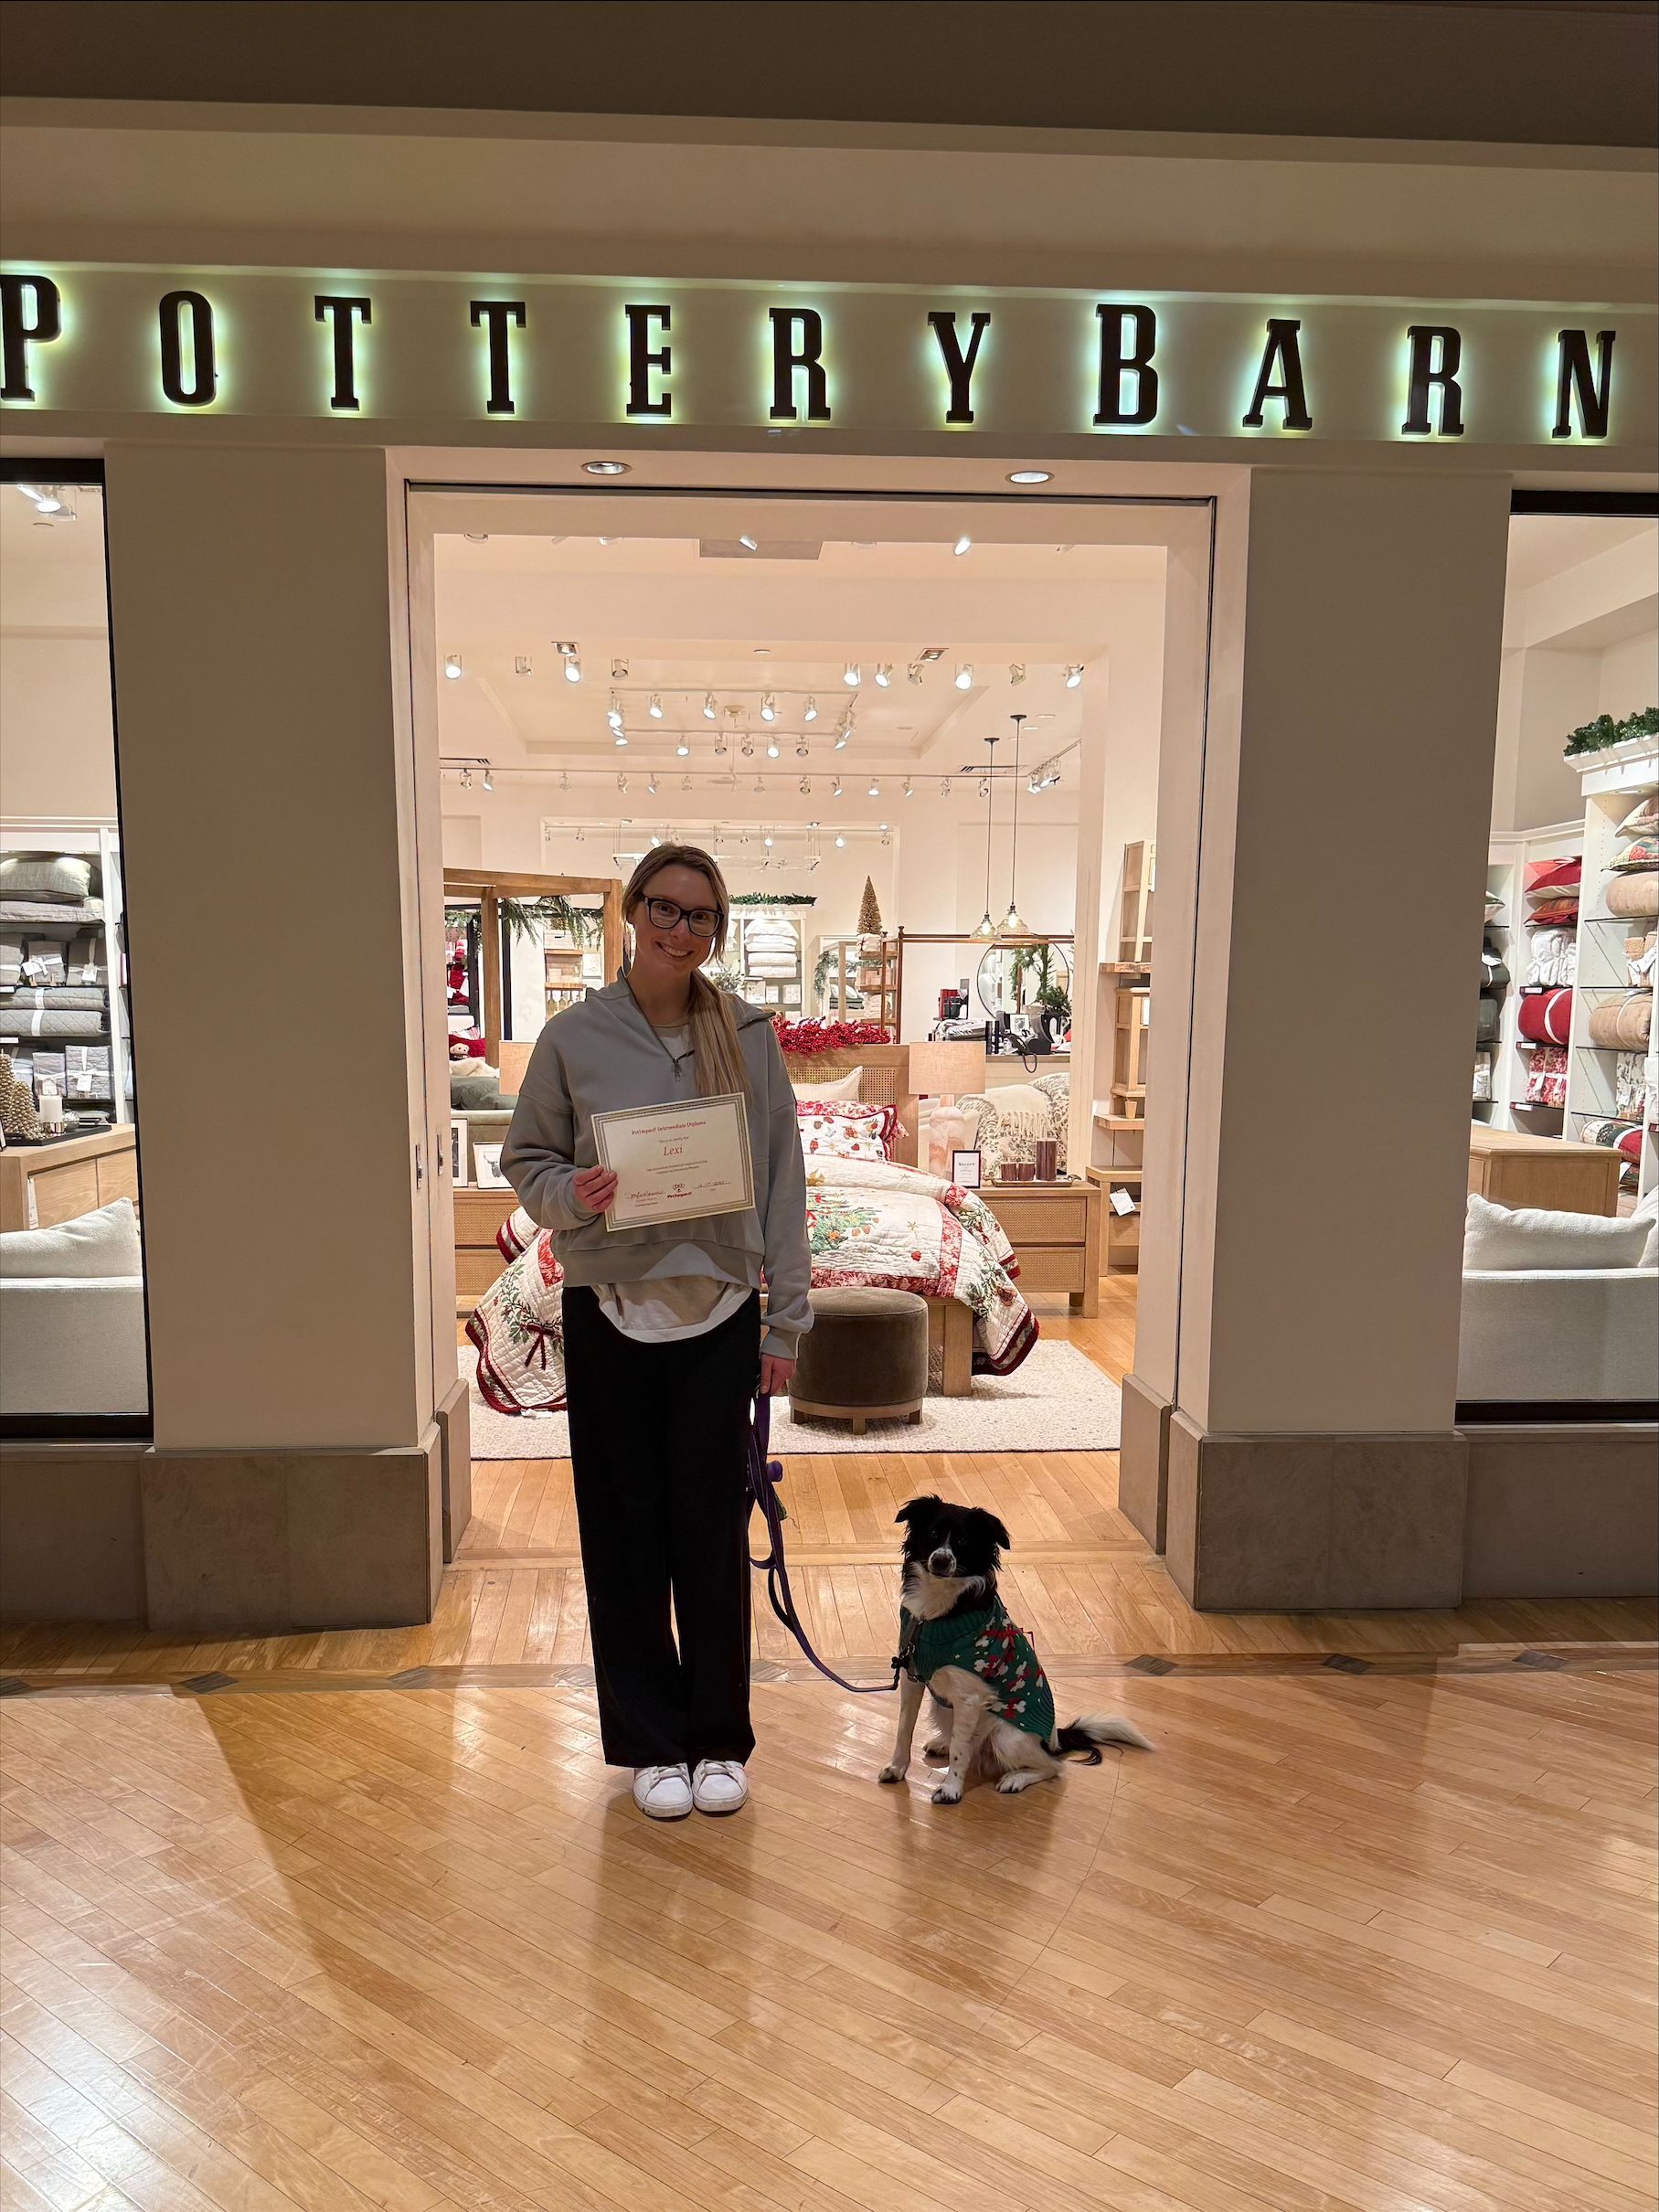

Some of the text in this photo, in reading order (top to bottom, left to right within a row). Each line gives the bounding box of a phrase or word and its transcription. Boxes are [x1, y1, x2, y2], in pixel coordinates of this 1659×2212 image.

[0, 273, 1617, 440] POTTERY BARN
[664, 1144, 683, 1156] Lexi
